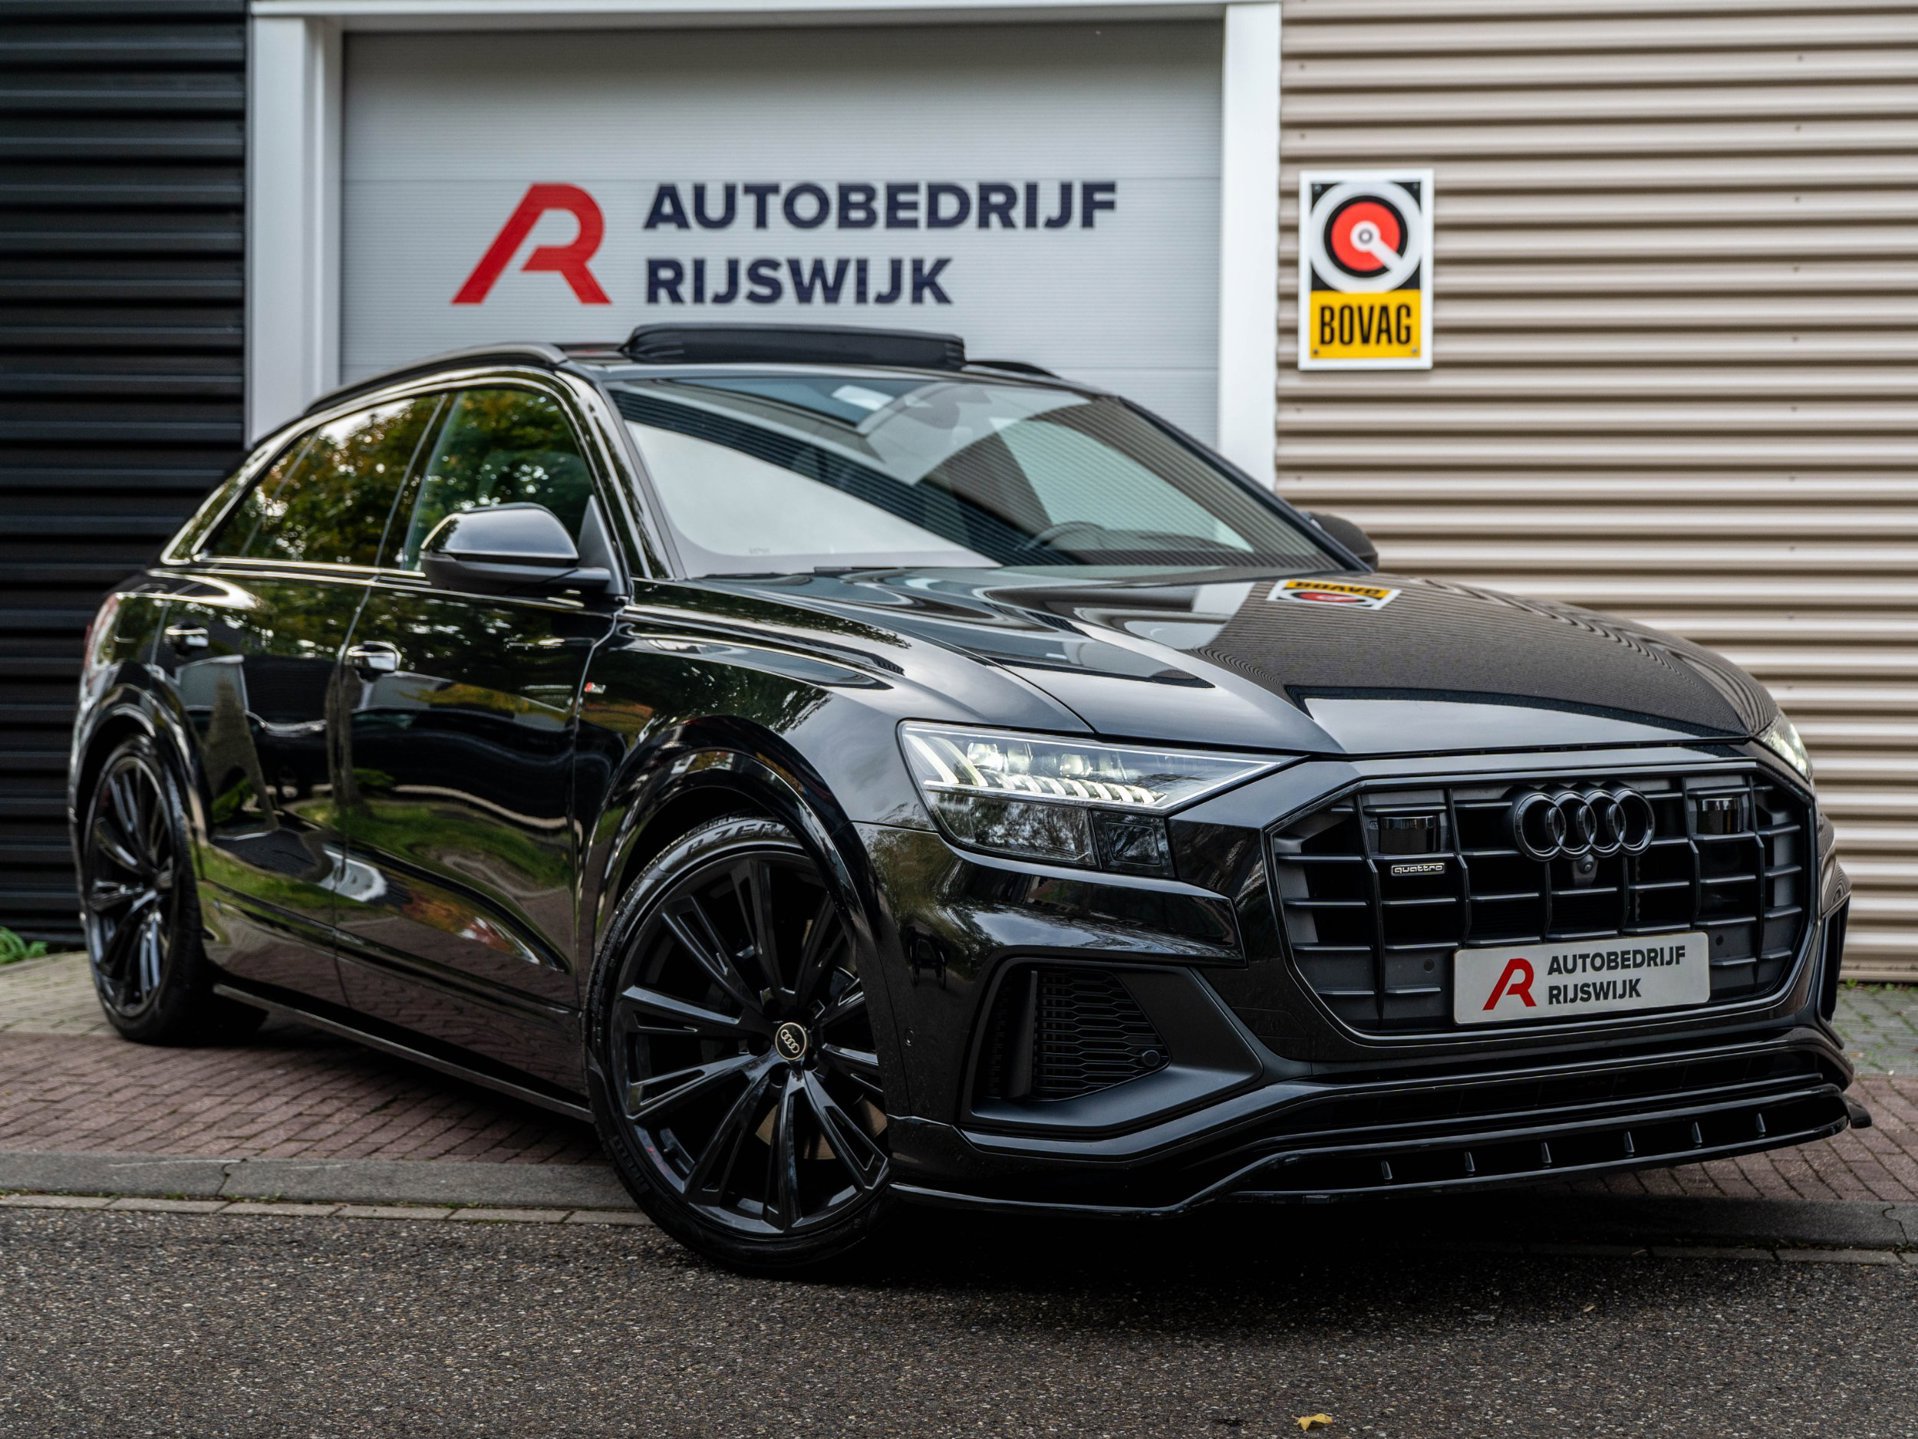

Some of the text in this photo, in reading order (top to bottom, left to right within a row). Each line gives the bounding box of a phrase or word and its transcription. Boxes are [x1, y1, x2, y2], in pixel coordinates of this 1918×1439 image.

[643, 181, 1117, 231] AUTOBEDRIJF
[645, 257, 953, 304] RIJSWIJK
[1320, 304, 1411, 346] BOVAG
[1393, 864, 1443, 874] quattro
[1547, 945, 1686, 976] AUTOBEDRIJF
[1548, 978, 1642, 1005] RIJSWIJK
